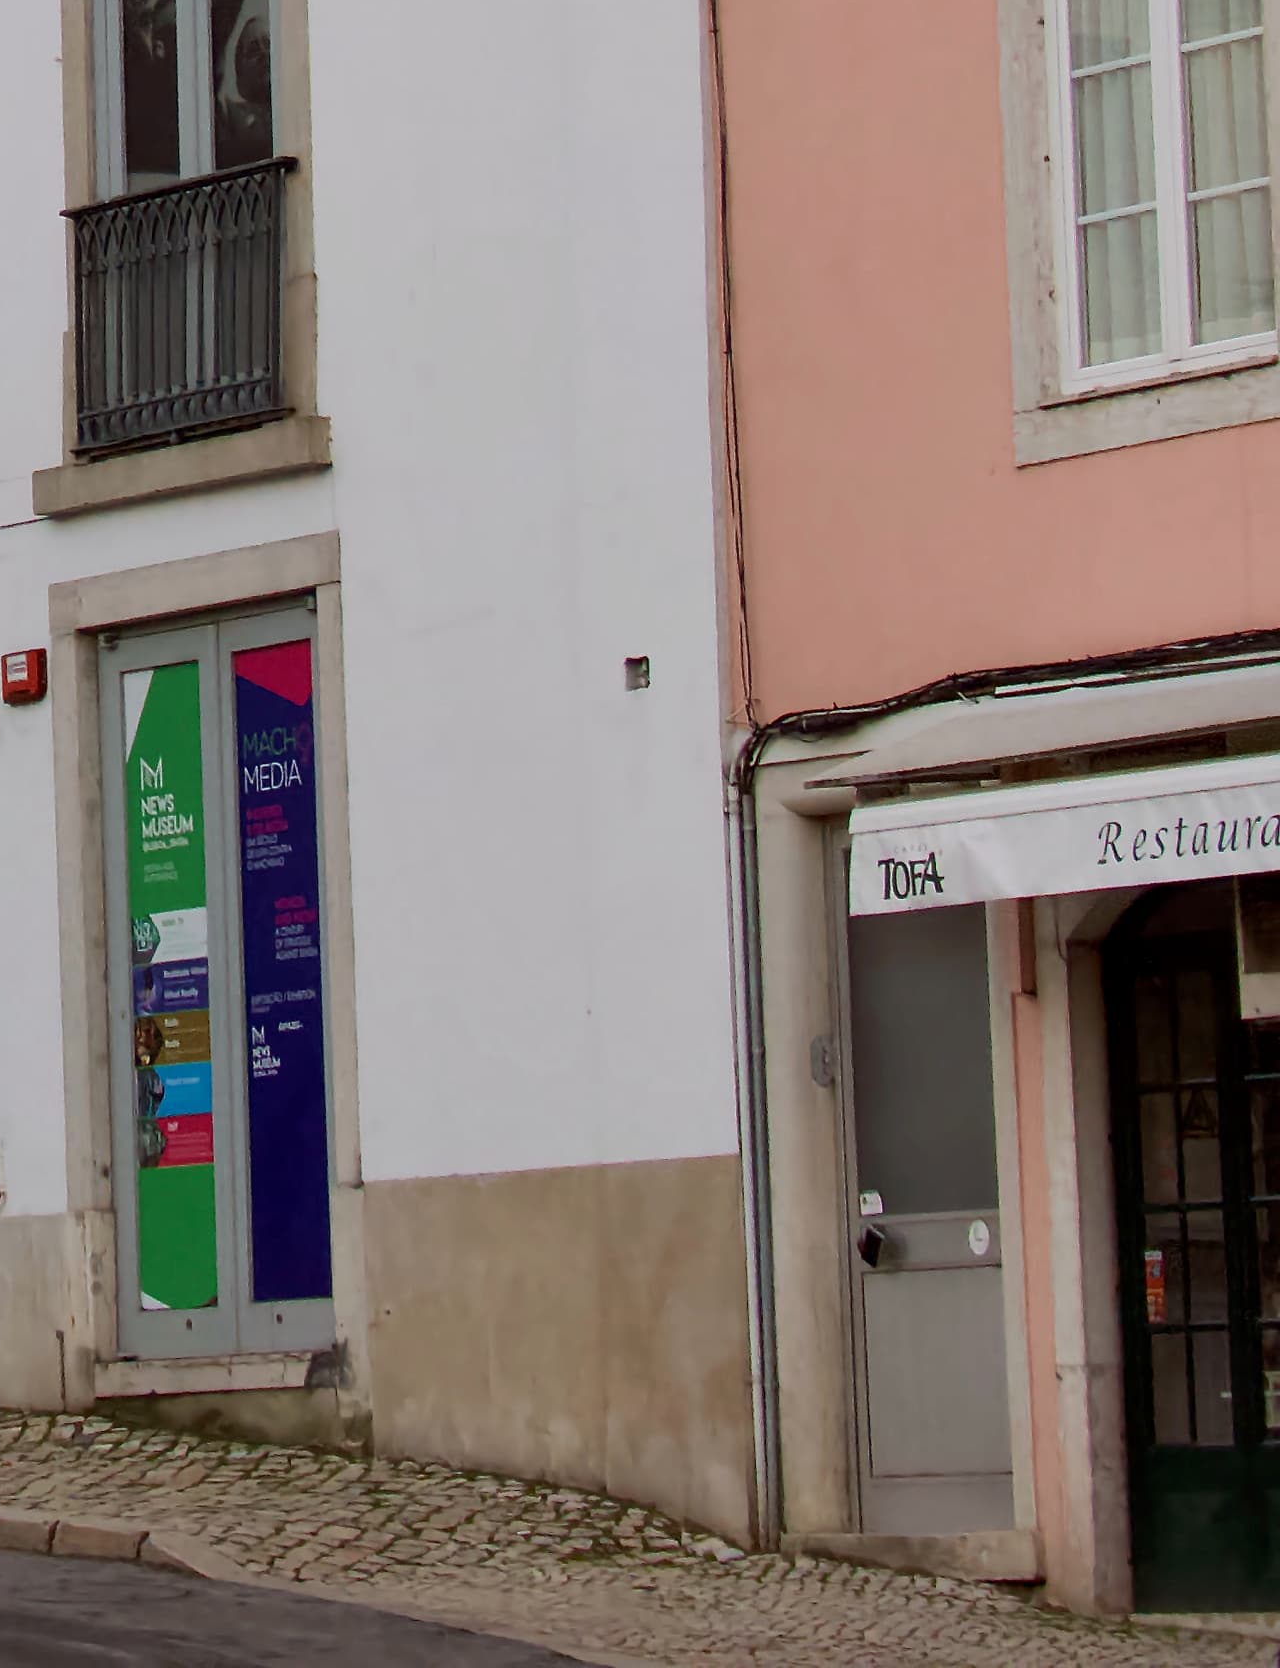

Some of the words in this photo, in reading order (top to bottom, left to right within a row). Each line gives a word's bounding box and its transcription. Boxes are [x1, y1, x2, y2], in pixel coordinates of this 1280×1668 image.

[244, 759, 302, 794] MEDIA
[141, 793, 174, 817] NEWS
[142, 813, 194, 838] MUSEUM
[877, 852, 945, 900] TOFA
